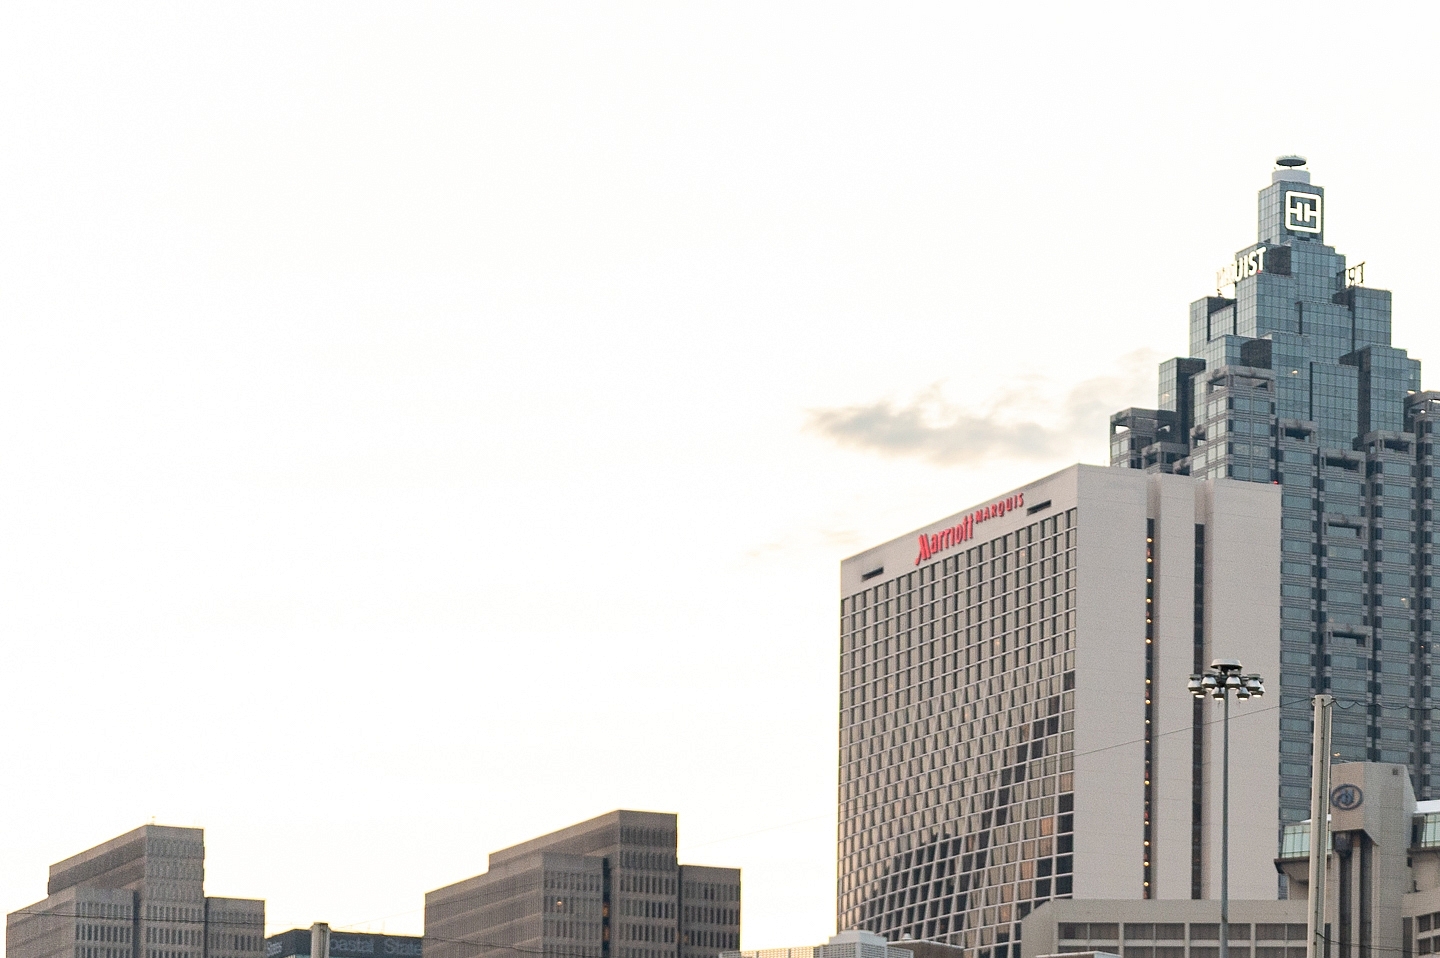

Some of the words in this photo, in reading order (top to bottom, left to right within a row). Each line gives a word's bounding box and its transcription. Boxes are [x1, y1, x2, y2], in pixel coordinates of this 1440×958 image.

[915, 513, 974, 566] Marriott
[975, 492, 1024, 525] MARQUIS
[330, 938, 374, 953] oastal
[384, 938, 423, 955] State
